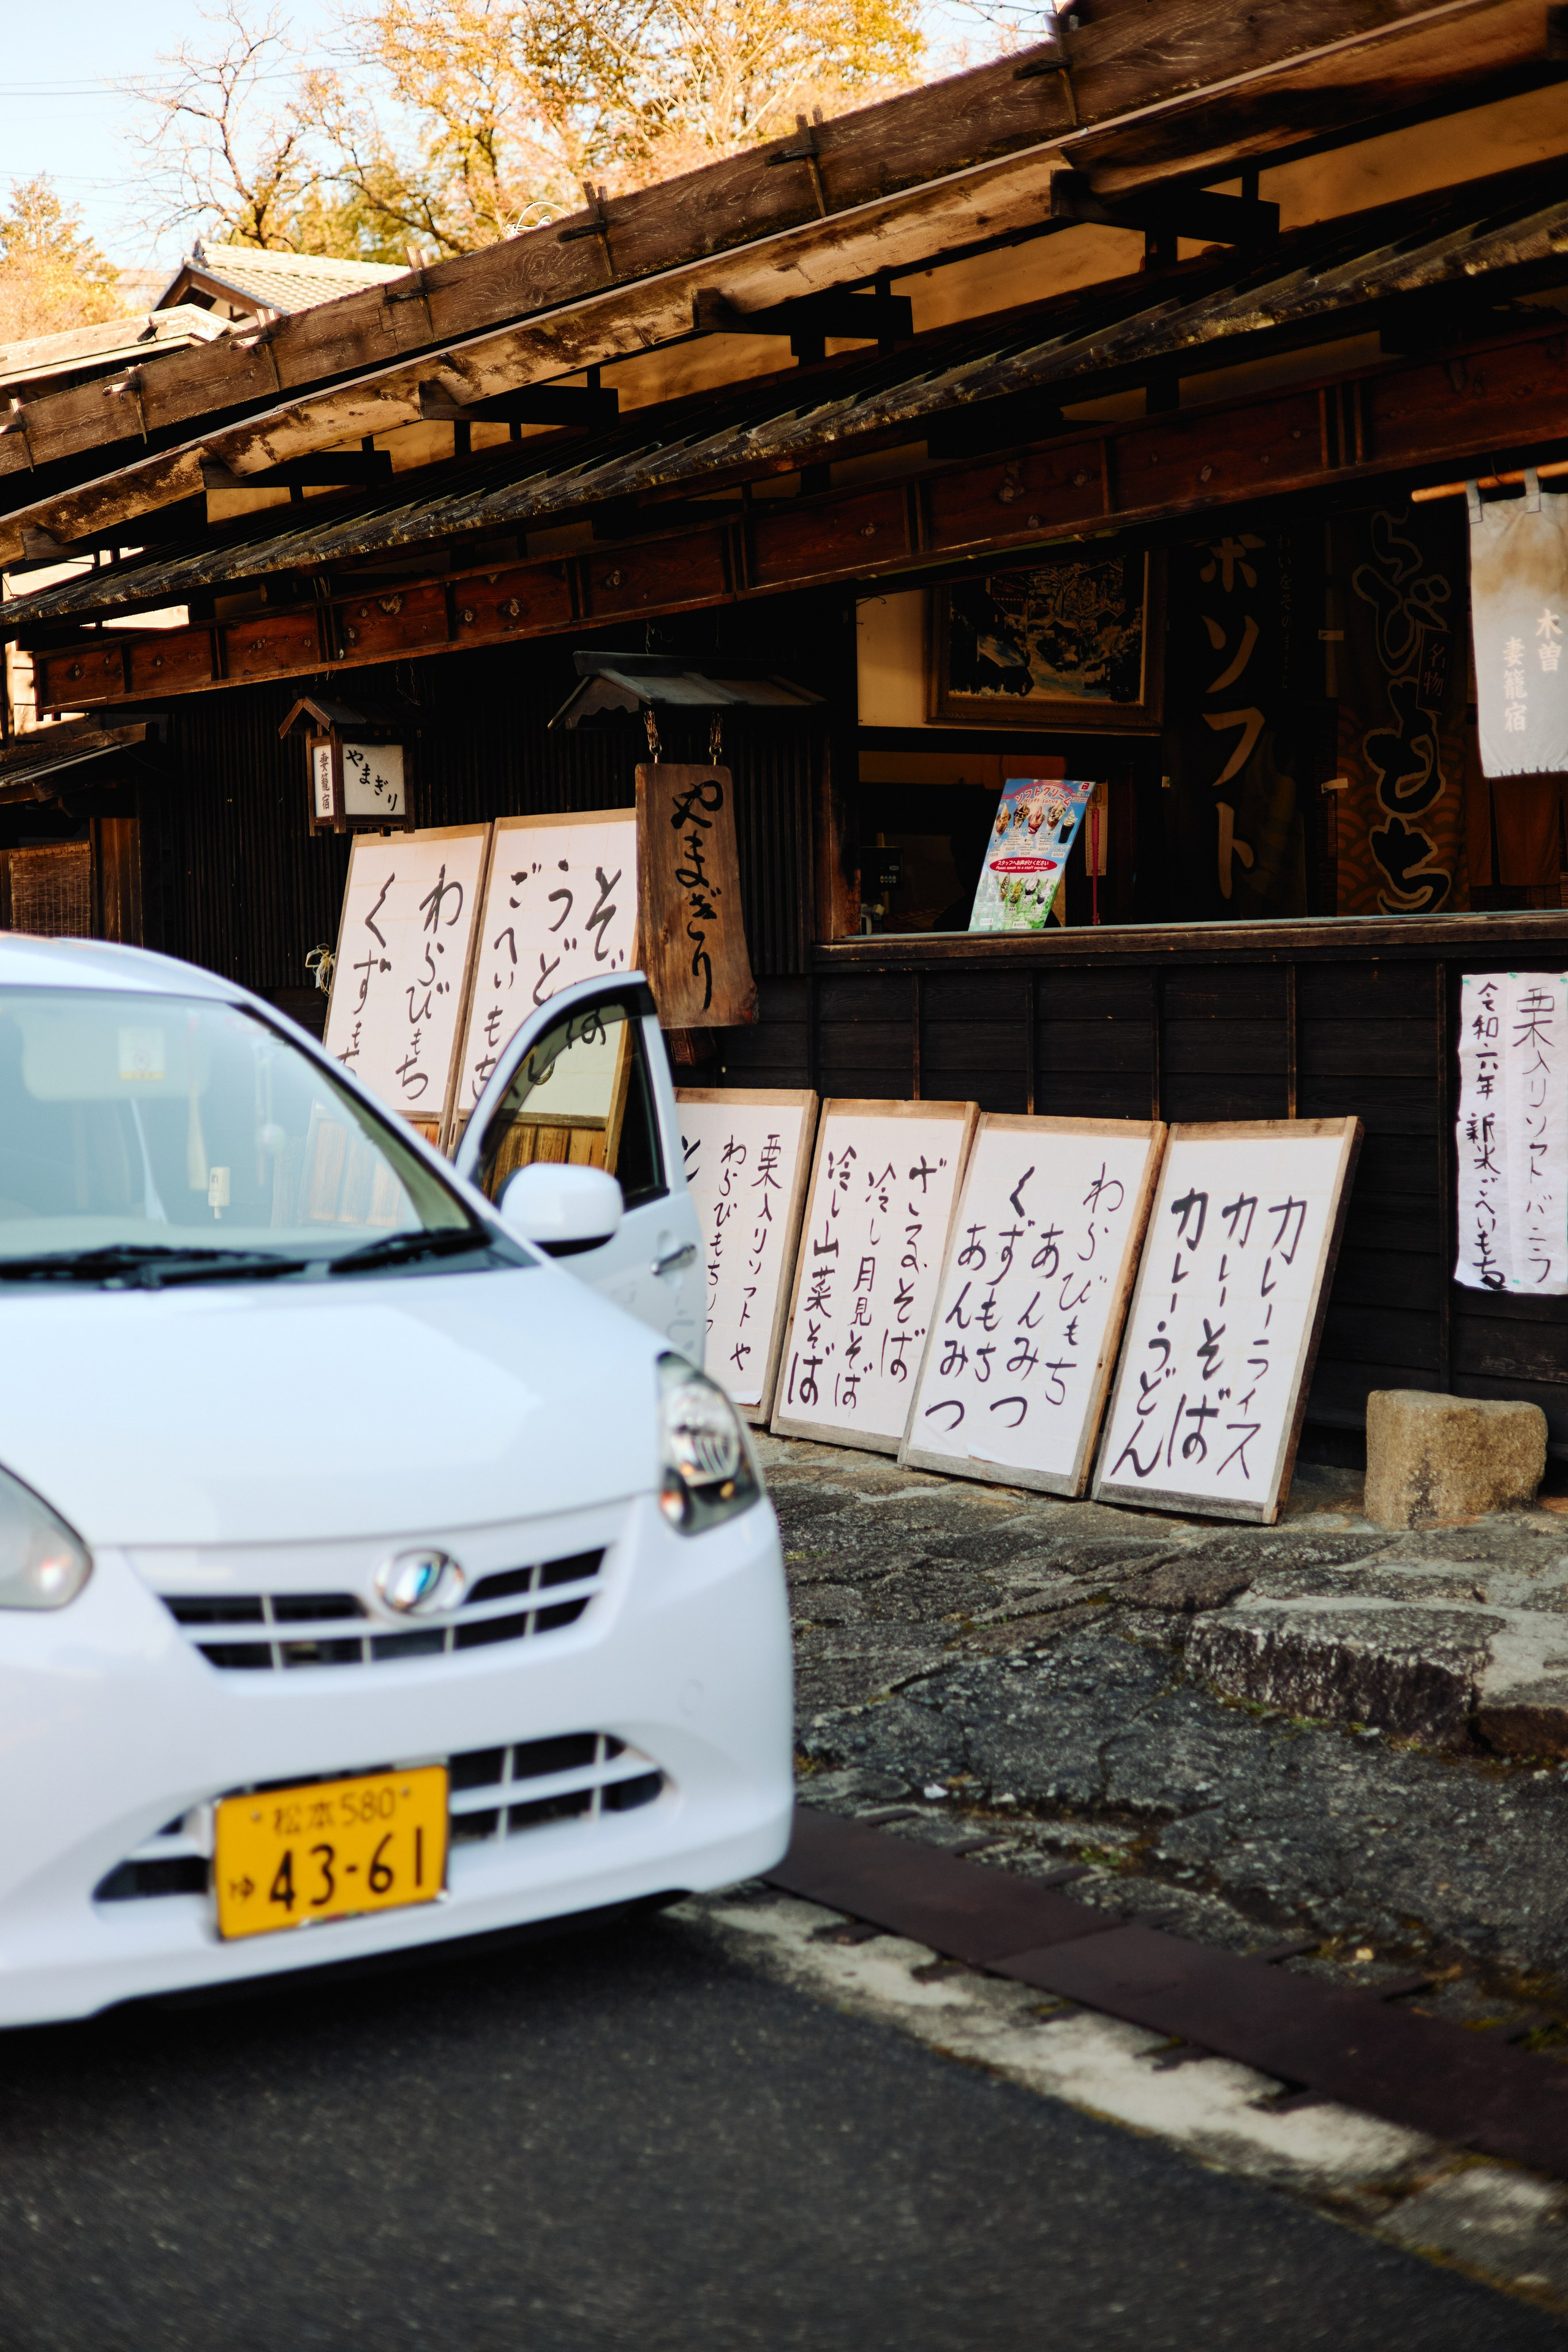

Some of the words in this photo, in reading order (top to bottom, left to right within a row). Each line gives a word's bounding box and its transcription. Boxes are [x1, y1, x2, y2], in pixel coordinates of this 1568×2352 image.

[1422, 643, 1447, 698] 名物
[1503, 636, 1527, 733] 妻籠宿
[1536, 608, 1562, 671] 木曽
[318, 750, 331, 811] 妻籠宿
[345, 749, 399, 812] やまぎり
[1016, 786, 1072, 807] ソフトクリーム
[396, 863, 463, 1099] わらびもち
[671, 780, 724, 1013] やまぎり
[788, 1145, 858, 1406] 冷し山菜そば
[835, 1162, 897, 1409] 冷し月見そば
[881, 1155, 948, 1383] ざるそば
[925, 1223, 987, 1432] あんみつ
[974, 1166, 1036, 1383] くずもち
[989, 1223, 1065, 1428] あんみつ
[1045, 1162, 1125, 1406] わらびもち
[1110, 1187, 1209, 1478] カレーうどん
[1167, 1192, 1259, 1468] カレーそば
[1216, 1195, 1308, 1480] カレーライス
[268, 1825, 423, 1913] 43-61
[273, 1800, 336, 1836] 松本
[340, 1787, 396, 1826] 580
